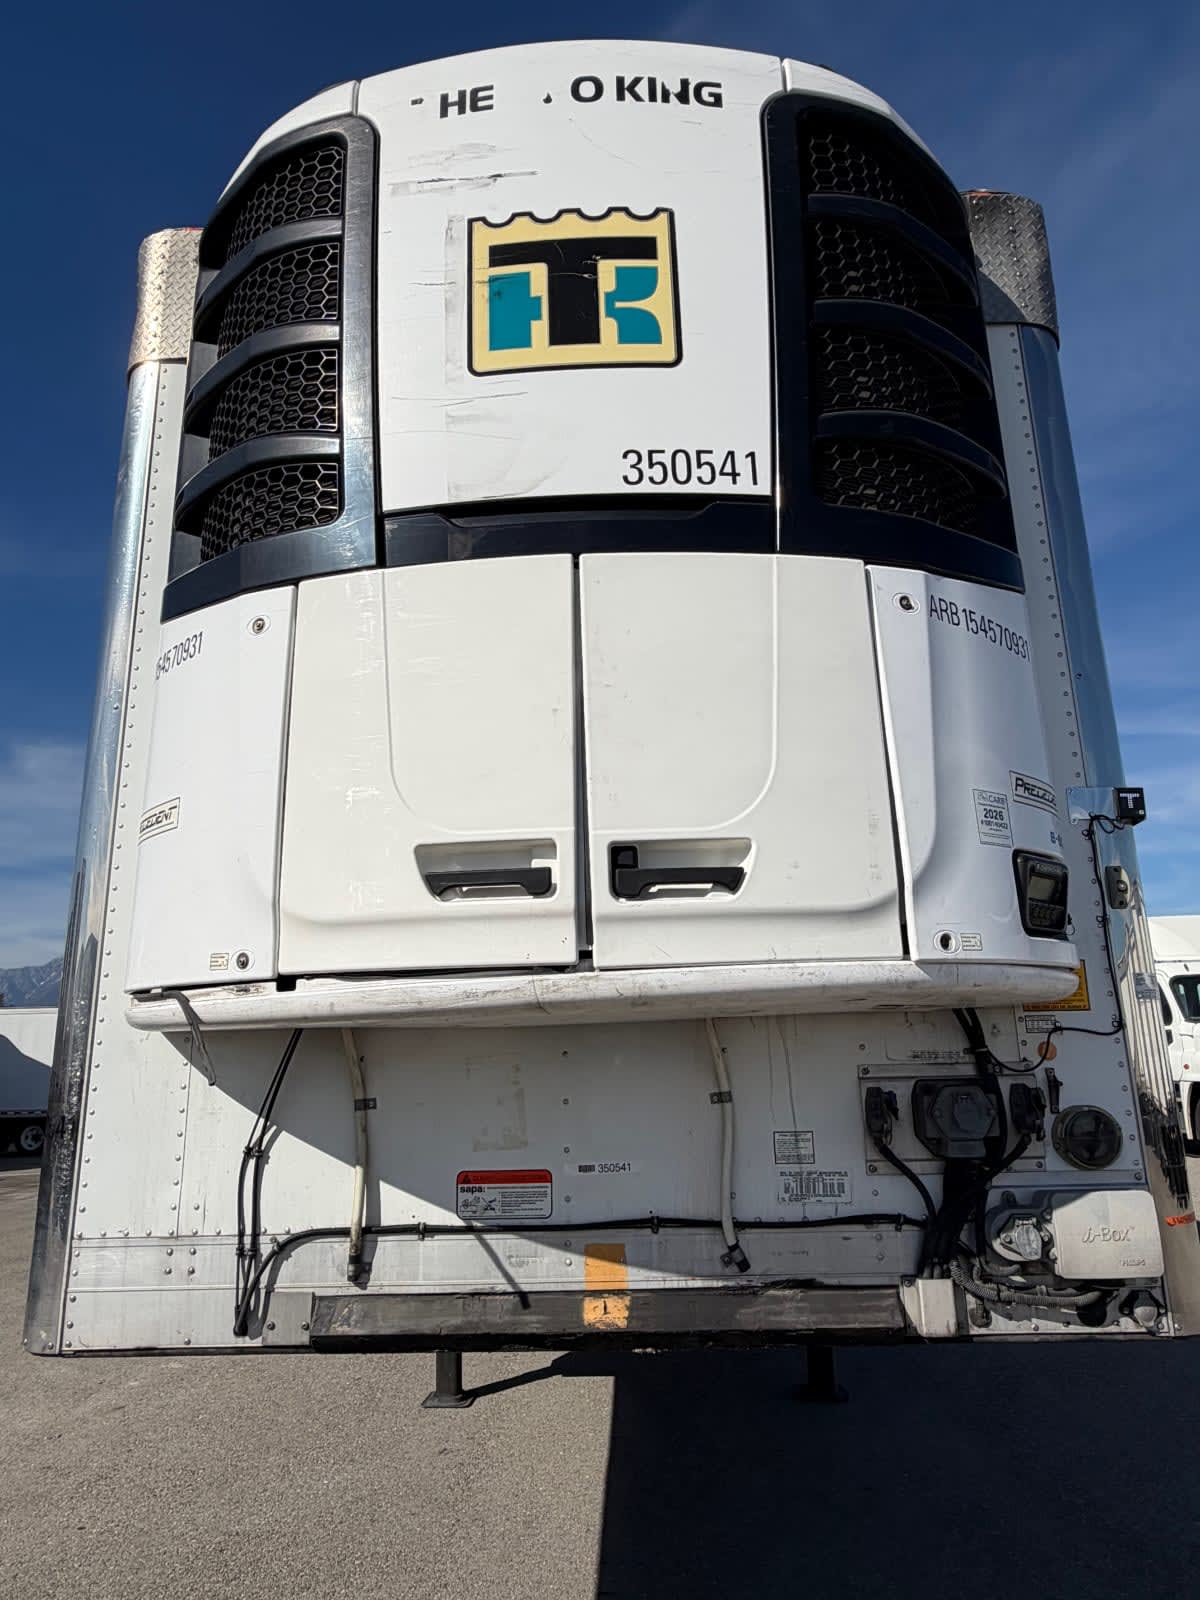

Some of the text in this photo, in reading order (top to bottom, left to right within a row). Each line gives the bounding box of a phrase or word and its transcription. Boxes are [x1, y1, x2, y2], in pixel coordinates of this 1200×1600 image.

[622, 449, 758, 486] 350541
[983, 808, 1004, 821] 2026
[598, 1163, 631, 1173] 350541
